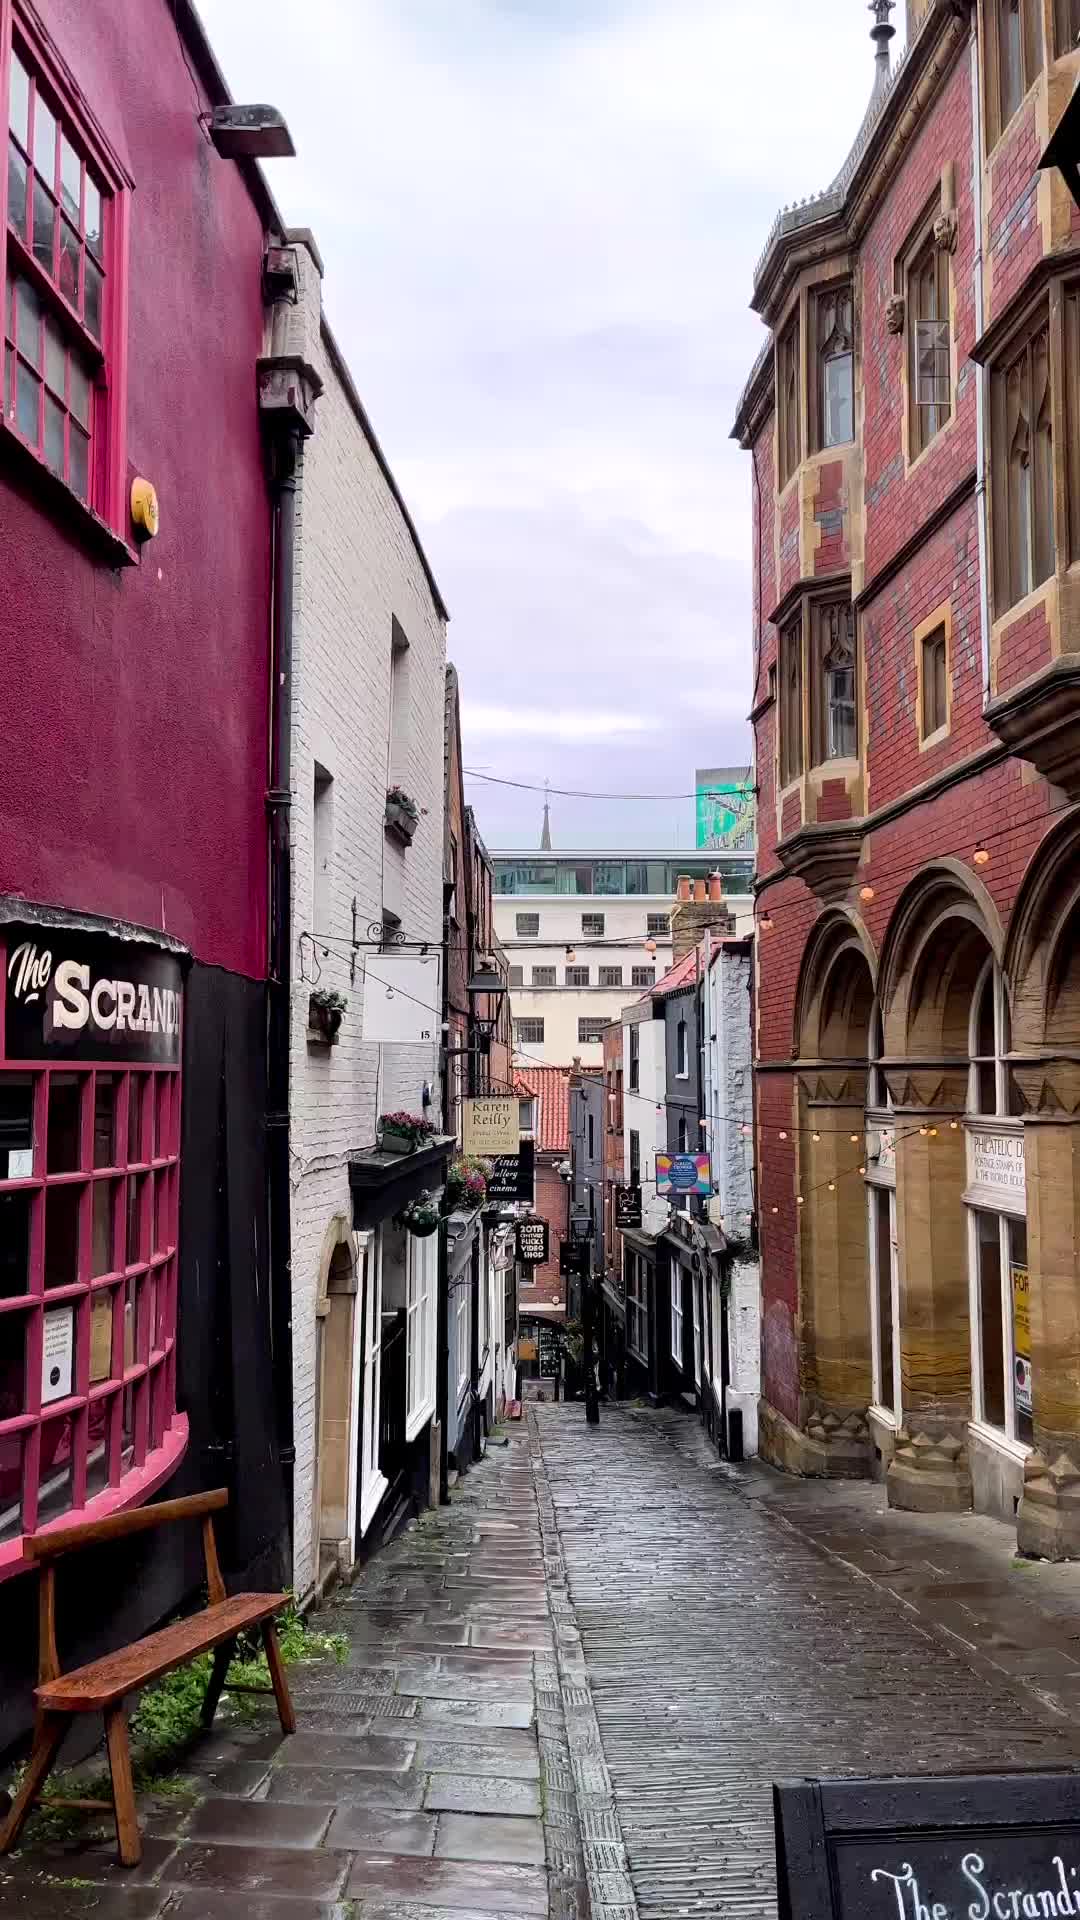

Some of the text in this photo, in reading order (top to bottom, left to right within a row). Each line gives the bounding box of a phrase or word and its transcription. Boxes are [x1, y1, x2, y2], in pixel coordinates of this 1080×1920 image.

[8, 942, 52, 999] The
[421, 1031, 430, 1040] 15
[472, 1101, 509, 1112] Karen
[472, 1112, 511, 1129] Reilly
[974, 1136, 1013, 1158] PHILATELIC
[871, 1863, 948, 1920] The
